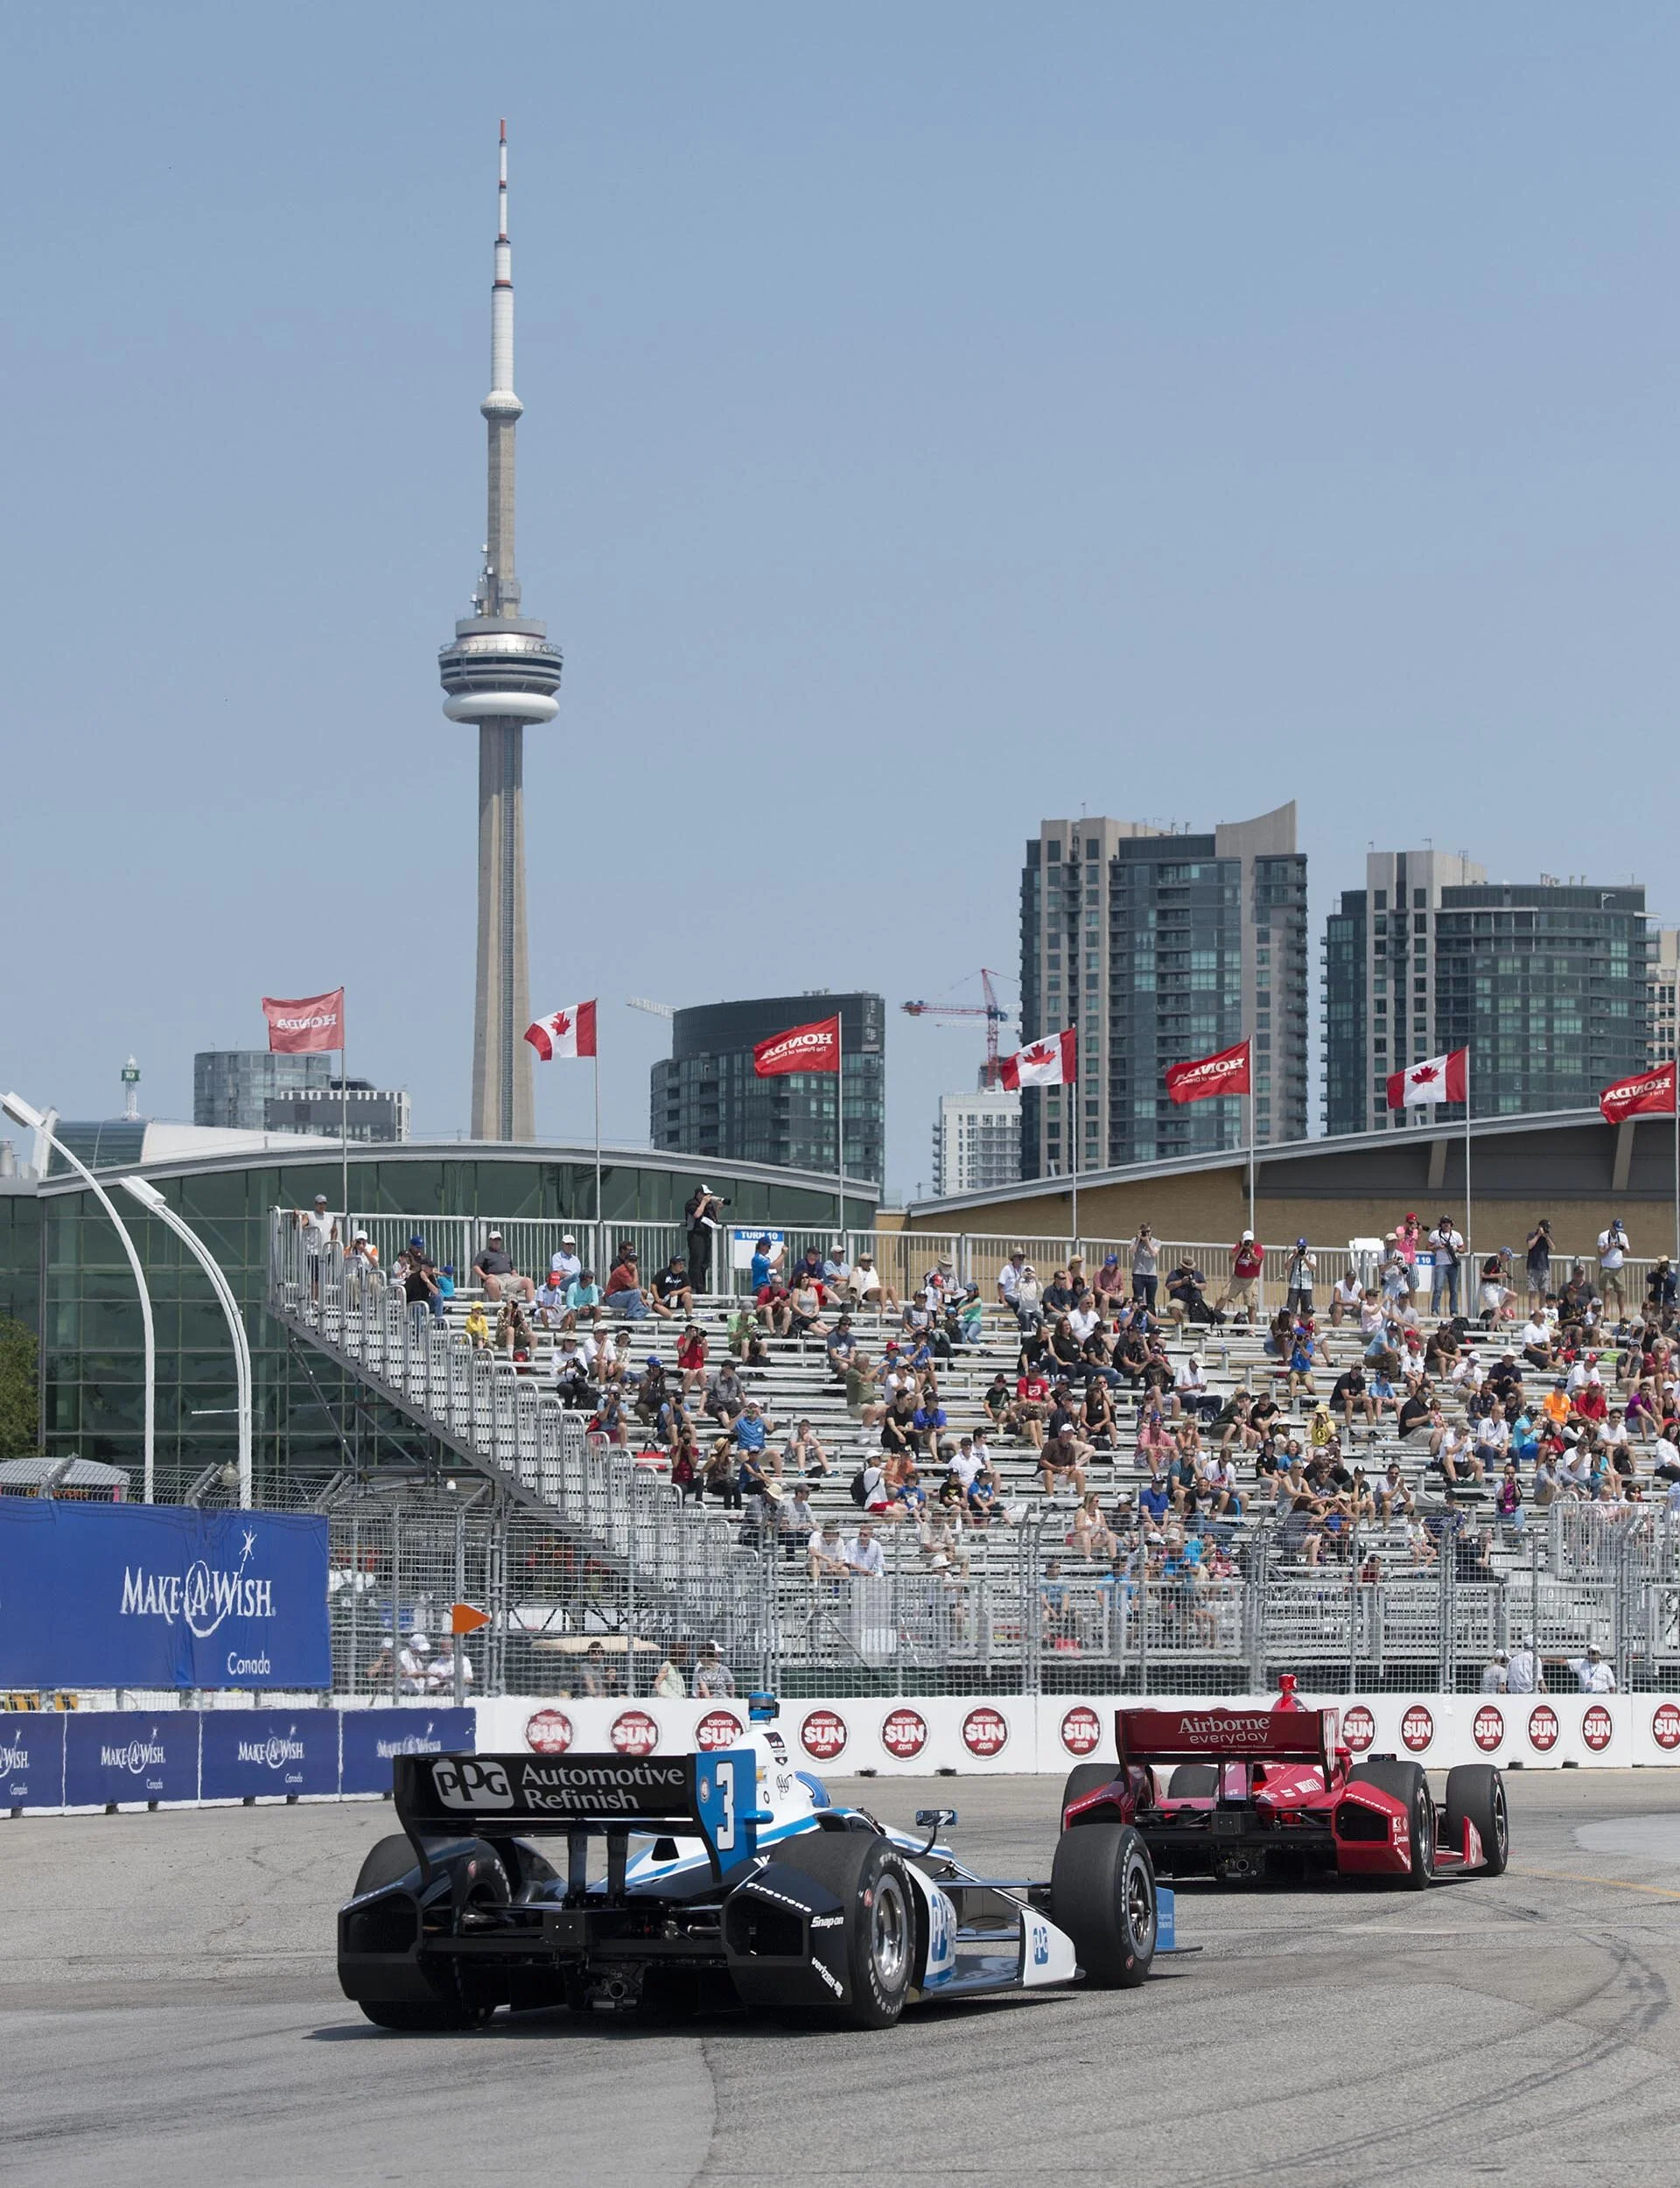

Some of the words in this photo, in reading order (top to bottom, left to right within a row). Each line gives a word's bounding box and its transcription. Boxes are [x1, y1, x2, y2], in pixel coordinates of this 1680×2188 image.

[740, 1231, 766, 1239] TURN
[766, 1231, 779, 1240] 10
[1421, 1256, 1432, 1265] 10
[227, 1650, 270, 1675] Canada
[964, 1723, 1004, 1742] SUN
[1062, 1722, 1099, 1741] SUN
[1179, 1716, 1269, 1735] Airborne
[1343, 1721, 1373, 1737] SUN
[1403, 1721, 1432, 1737] SUN
[1474, 1721, 1502, 1737] SUN
[1530, 1721, 1558, 1737] SUN
[1583, 1721, 1611, 1736] SUN
[1654, 1719, 1680, 1736] SUN
[612, 1727, 655, 1745] SUN
[697, 1727, 741, 1744] SUN
[803, 1726, 844, 1744] SUN
[884, 1726, 925, 1743] SUN
[1190, 1730, 1268, 1744] everyday
[438, 1760, 511, 1802] PPG
[521, 1763, 685, 1786] Automotive
[525, 1788, 640, 1810] Refinish
[716, 1762, 735, 1850] 3
[746, 1883, 813, 1913] Firestone
